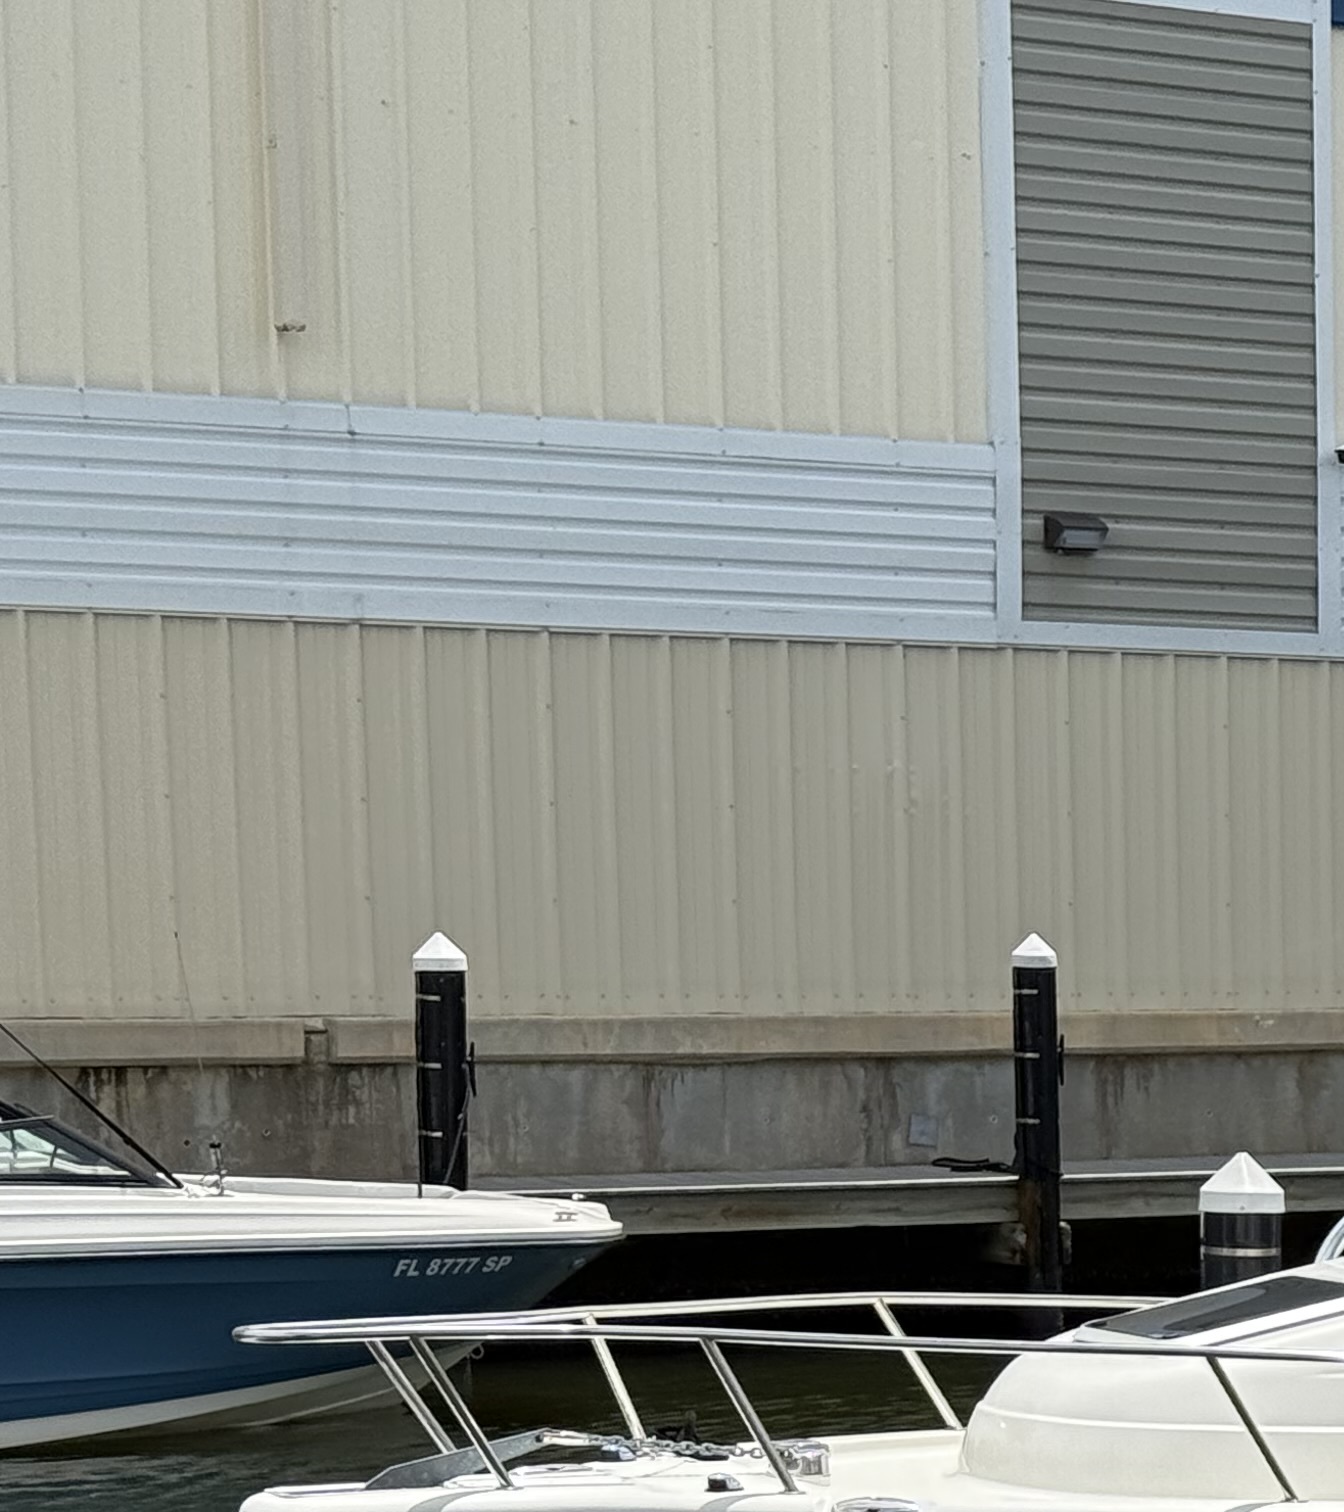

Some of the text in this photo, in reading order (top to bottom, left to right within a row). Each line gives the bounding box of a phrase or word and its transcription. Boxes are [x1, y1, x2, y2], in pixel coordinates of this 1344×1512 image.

[393, 1255, 513, 1278] FL 8777 SP
